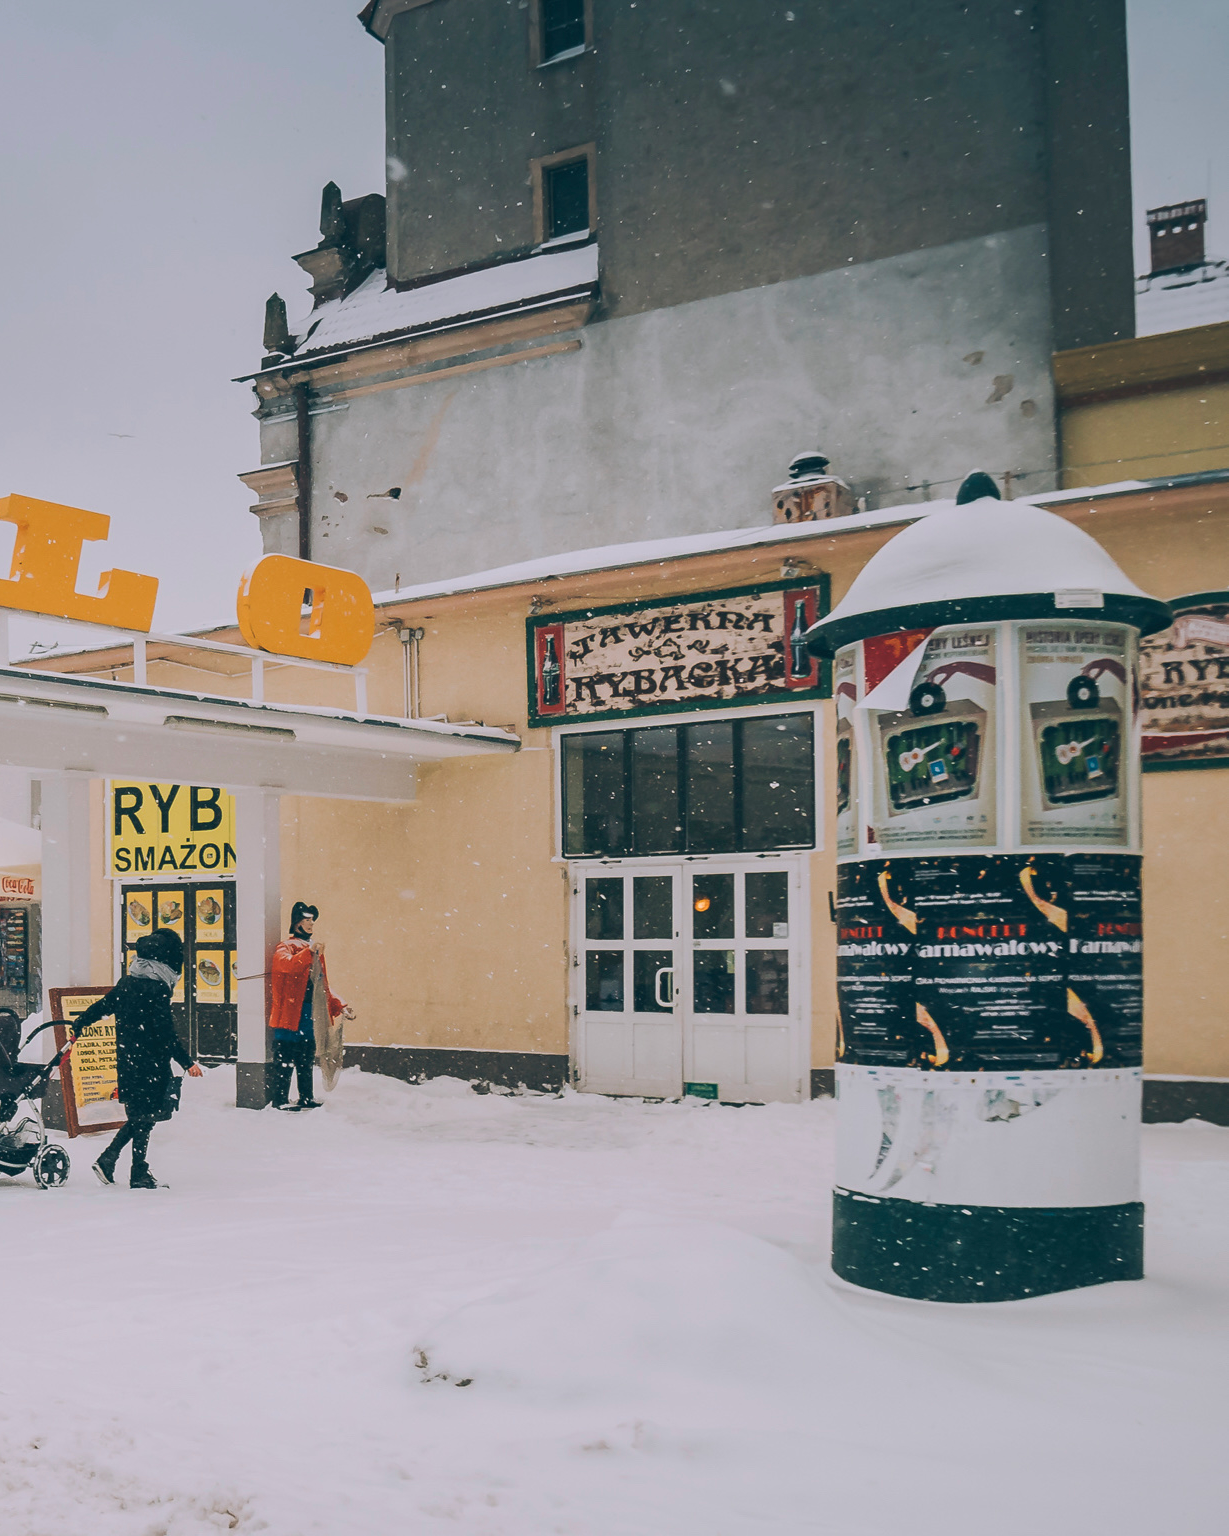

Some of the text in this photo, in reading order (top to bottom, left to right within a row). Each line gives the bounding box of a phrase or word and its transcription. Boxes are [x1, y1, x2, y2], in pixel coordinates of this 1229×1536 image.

[569, 610, 775, 667] TAWERNA
[569, 655, 783, 703] RYBACKA
[114, 784, 223, 836] RYB
